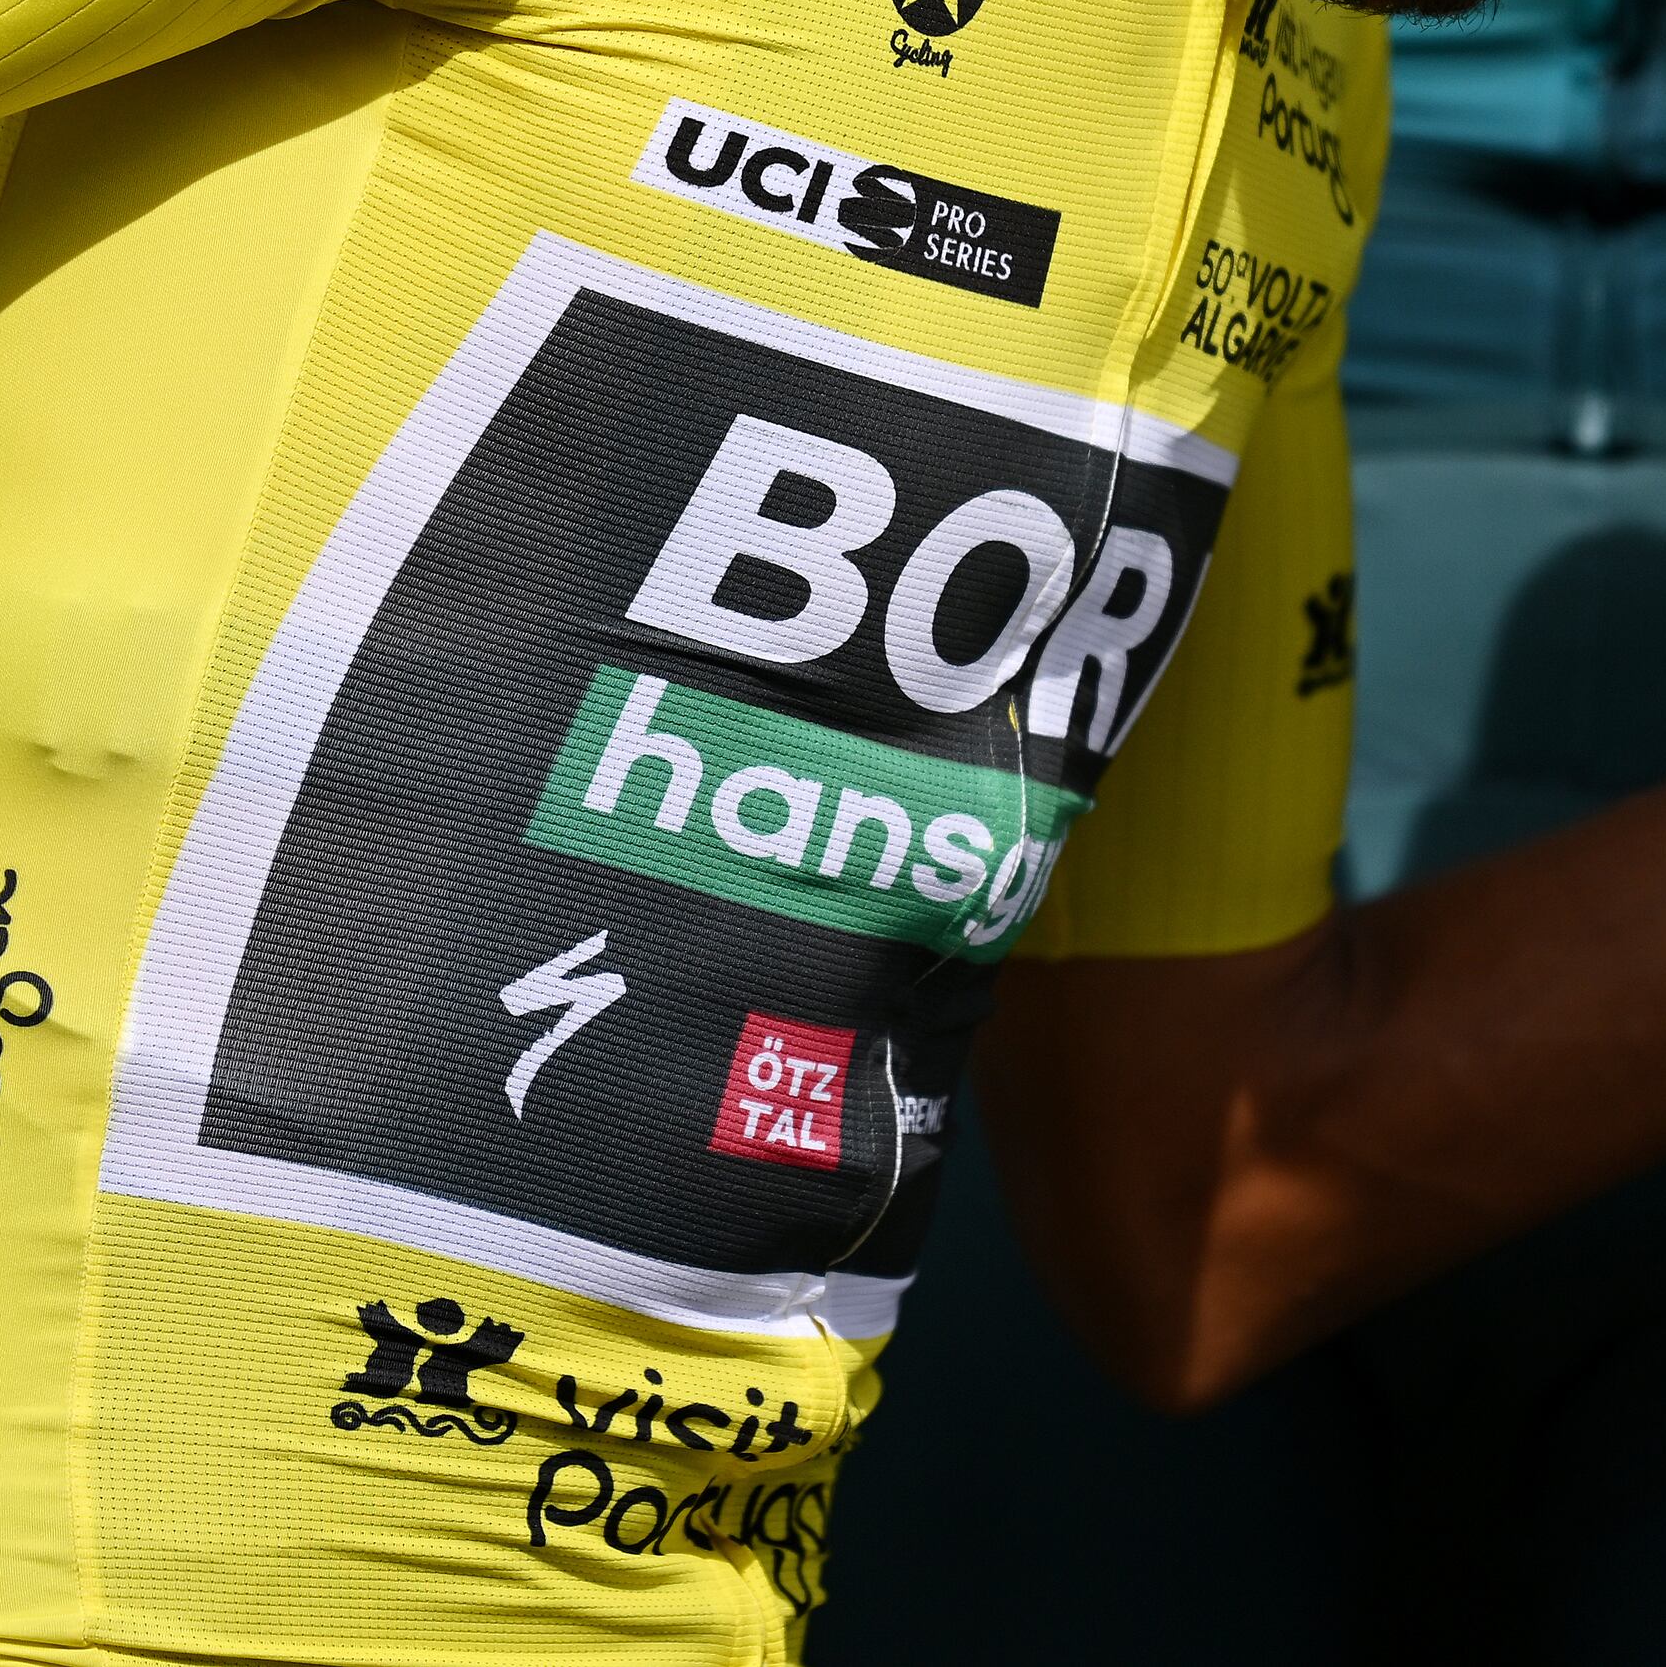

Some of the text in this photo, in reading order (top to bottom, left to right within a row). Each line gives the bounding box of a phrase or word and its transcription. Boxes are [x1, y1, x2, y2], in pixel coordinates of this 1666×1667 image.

[890, 28, 954, 79] Cycling
[665, 116, 834, 224] UCI
[930, 199, 987, 239] PRO
[923, 234, 1013, 282] SERIES
[624, 412, 1213, 759] BOR
[582, 672, 1067, 947] hansg
[747, 1037, 840, 1103] ÖTZ
[738, 1098, 827, 1152] TAL
